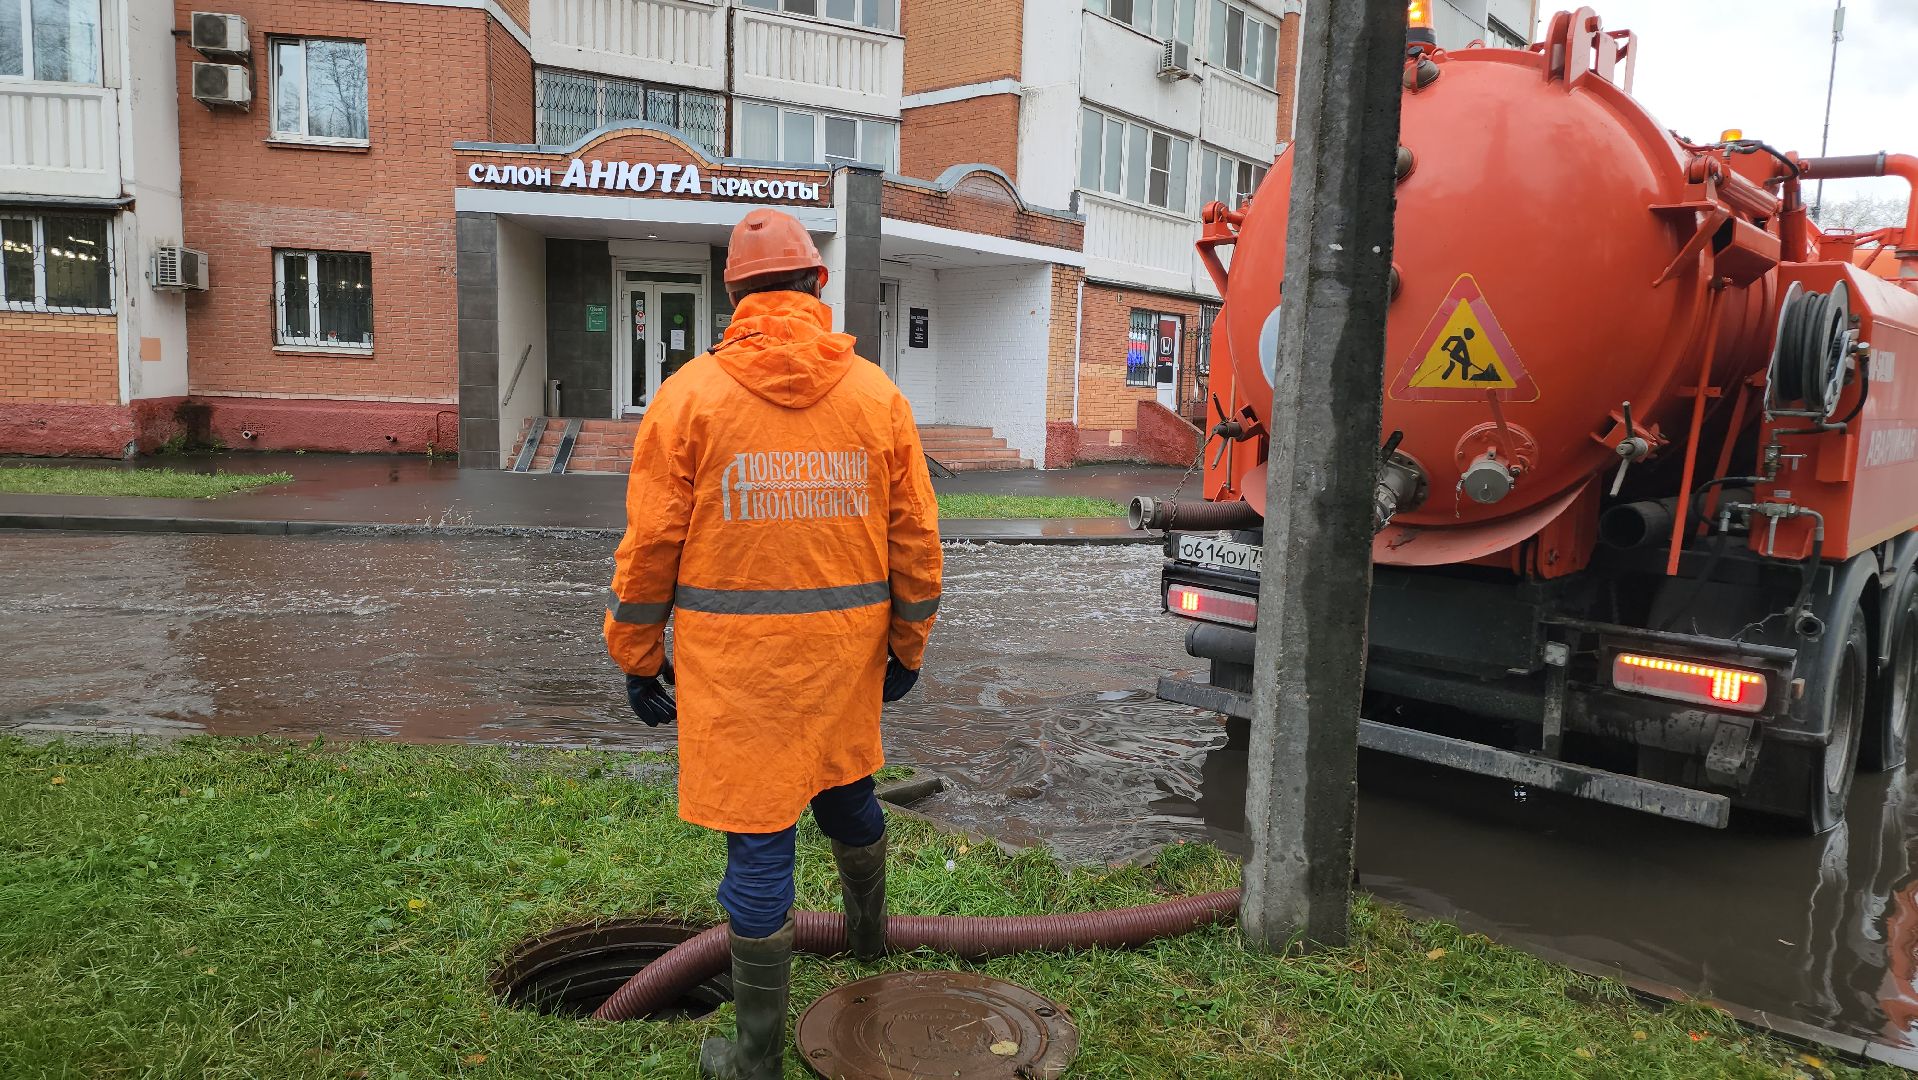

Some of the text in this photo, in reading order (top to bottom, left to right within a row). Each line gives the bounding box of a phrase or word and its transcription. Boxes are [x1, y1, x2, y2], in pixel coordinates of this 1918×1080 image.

[468, 158, 819, 200] САЛОН АНЮТА КРАСОТЫ
